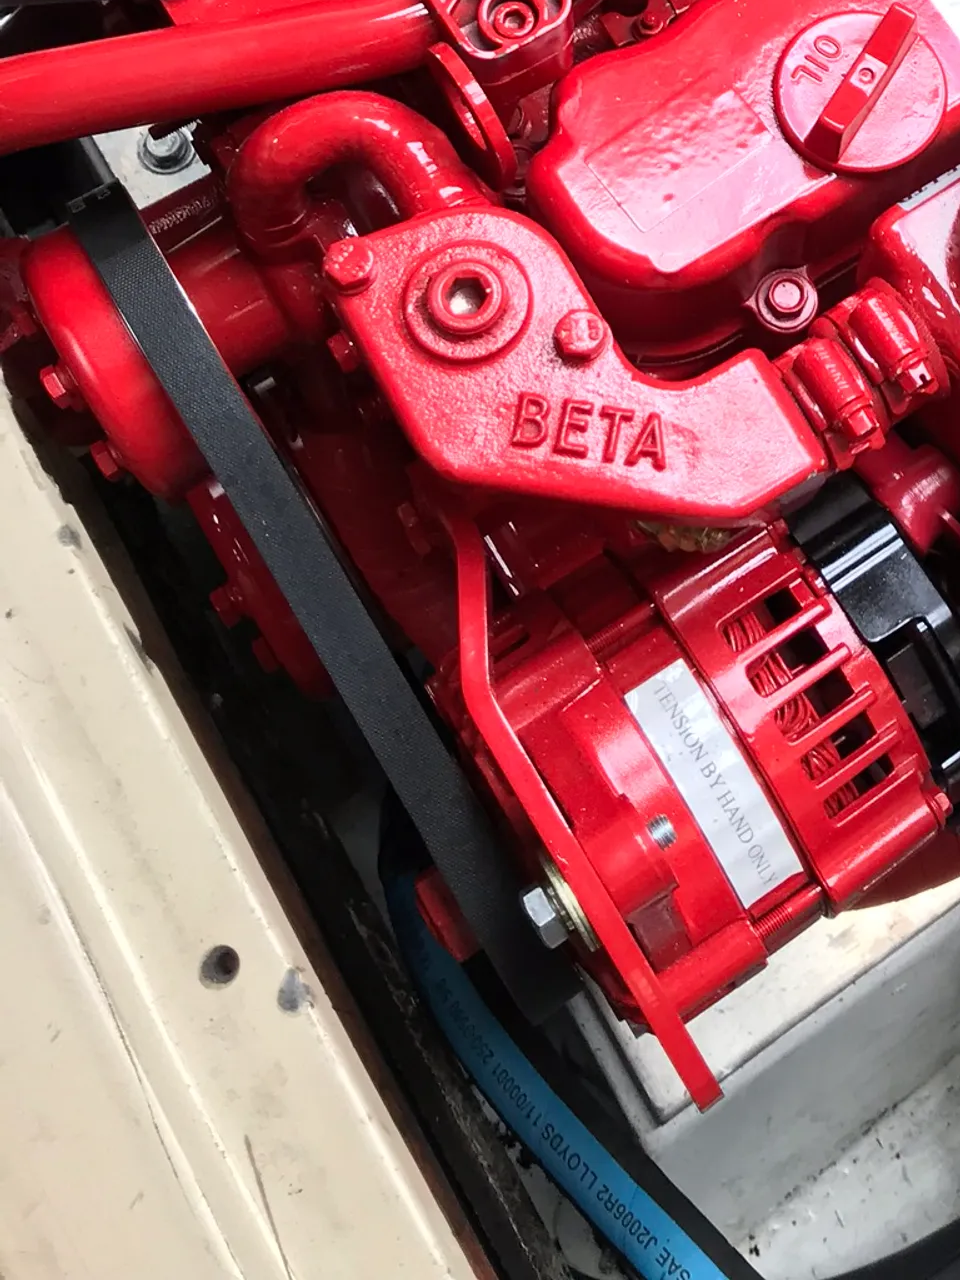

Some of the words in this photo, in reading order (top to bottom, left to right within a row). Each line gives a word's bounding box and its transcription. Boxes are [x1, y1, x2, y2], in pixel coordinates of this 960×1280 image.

[511, 394, 667, 470] BETA
[652, 681, 709, 762] TENSION
[700, 762, 726, 791] BY
[716, 790, 755, 845] HAND
[747, 844, 781, 887] ONLY
[492, 1062, 543, 1127] 11/00001
[541, 1123, 598, 1190] LLOYDS
[596, 1183, 658, 1251] J2006R2
